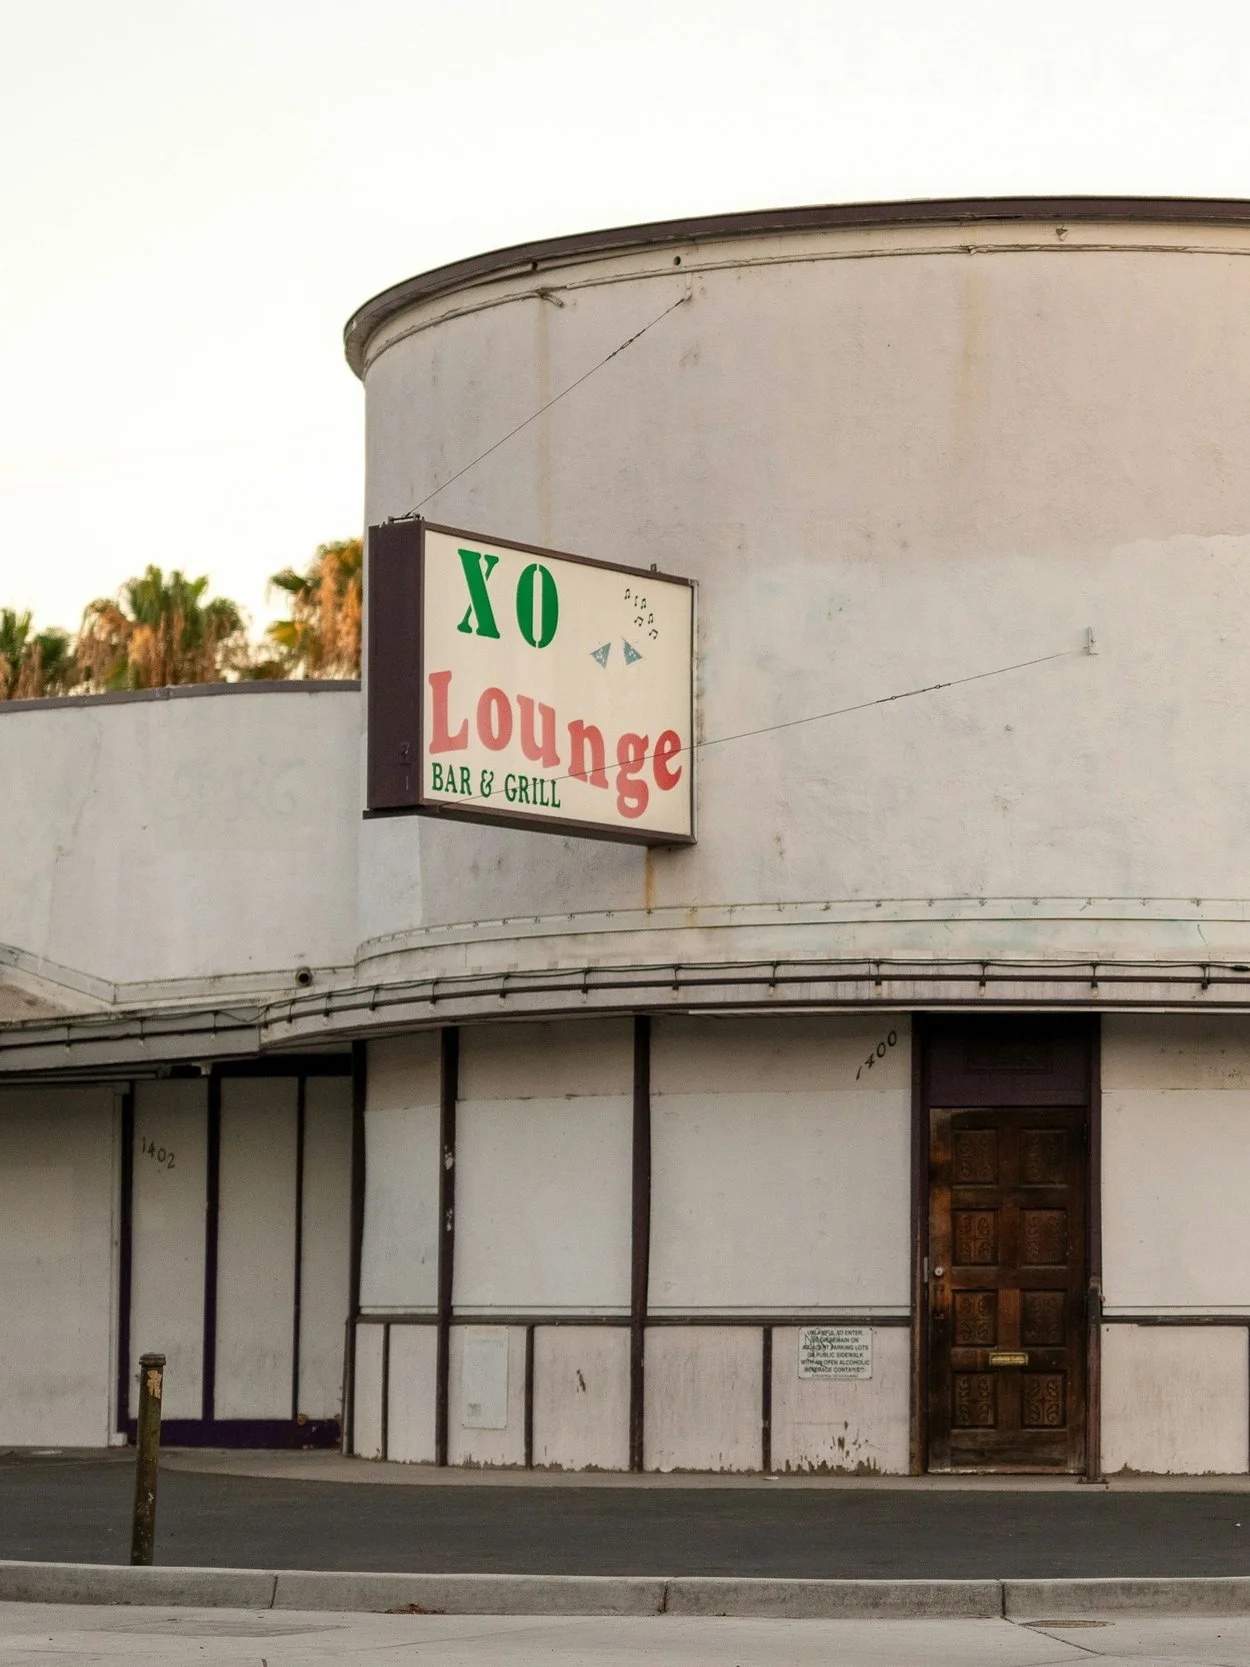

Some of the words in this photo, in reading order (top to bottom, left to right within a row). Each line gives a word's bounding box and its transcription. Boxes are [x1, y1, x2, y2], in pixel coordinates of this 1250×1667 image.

[457, 548, 559, 649] XO
[428, 670, 682, 819] Lounge
[432, 762, 472, 796] BAR
[480, 769, 494, 797] &
[504, 773, 561, 808] GRILL
[856, 1030, 897, 1081] 1400
[142, 1136, 175, 1169] 1402
